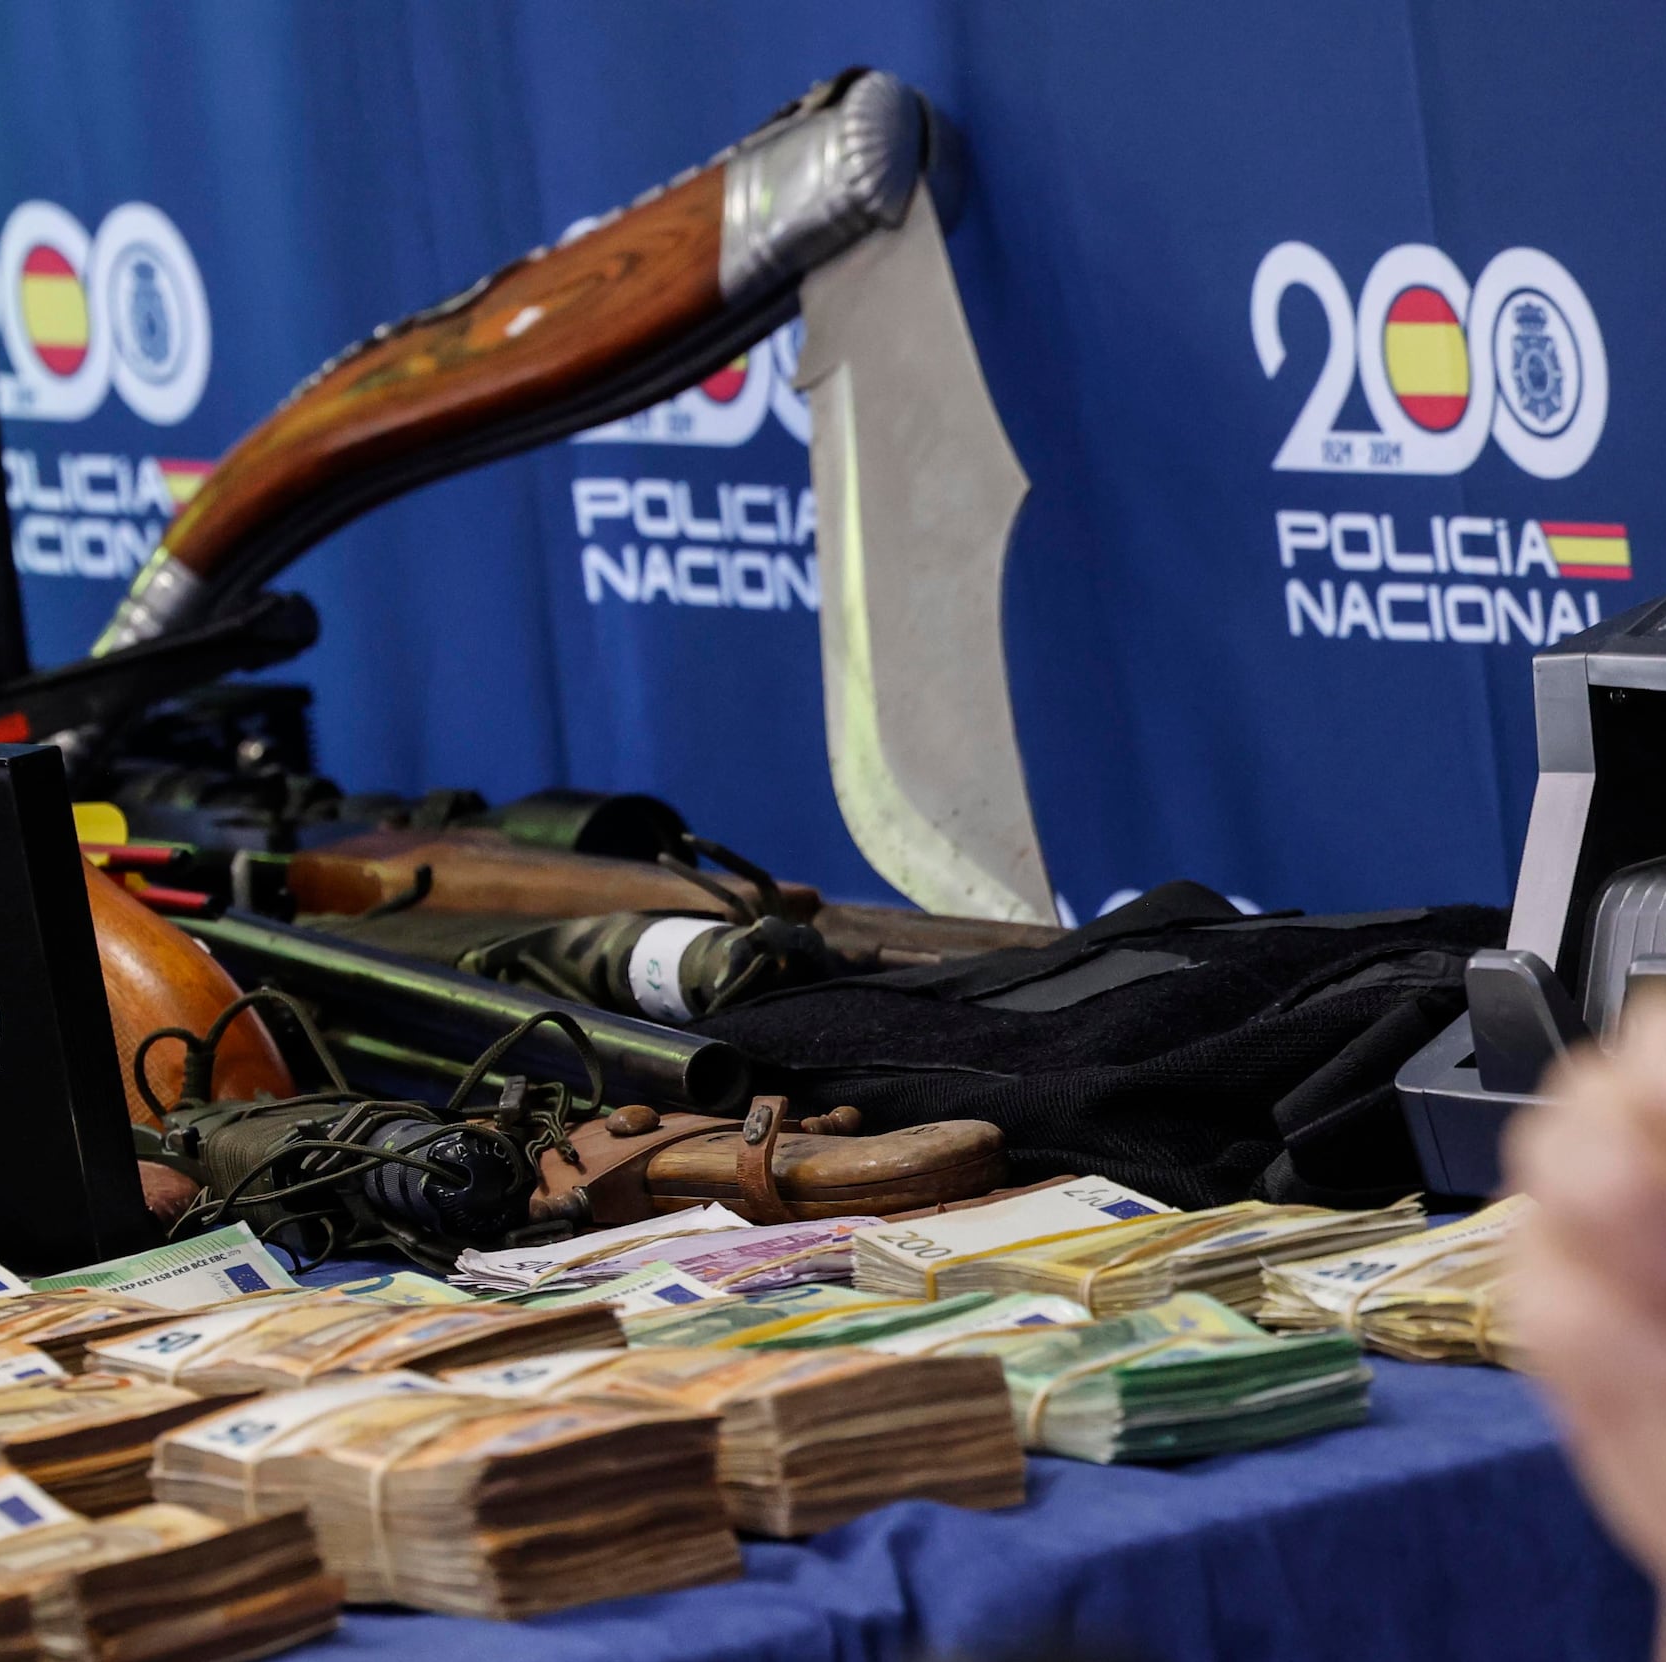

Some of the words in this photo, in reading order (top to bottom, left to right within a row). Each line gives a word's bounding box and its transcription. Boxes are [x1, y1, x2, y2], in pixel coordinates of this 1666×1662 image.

[1250, 240, 1609, 480] 200
[582, 544, 821, 612] NACION
[877, 1230, 952, 1259] 200
